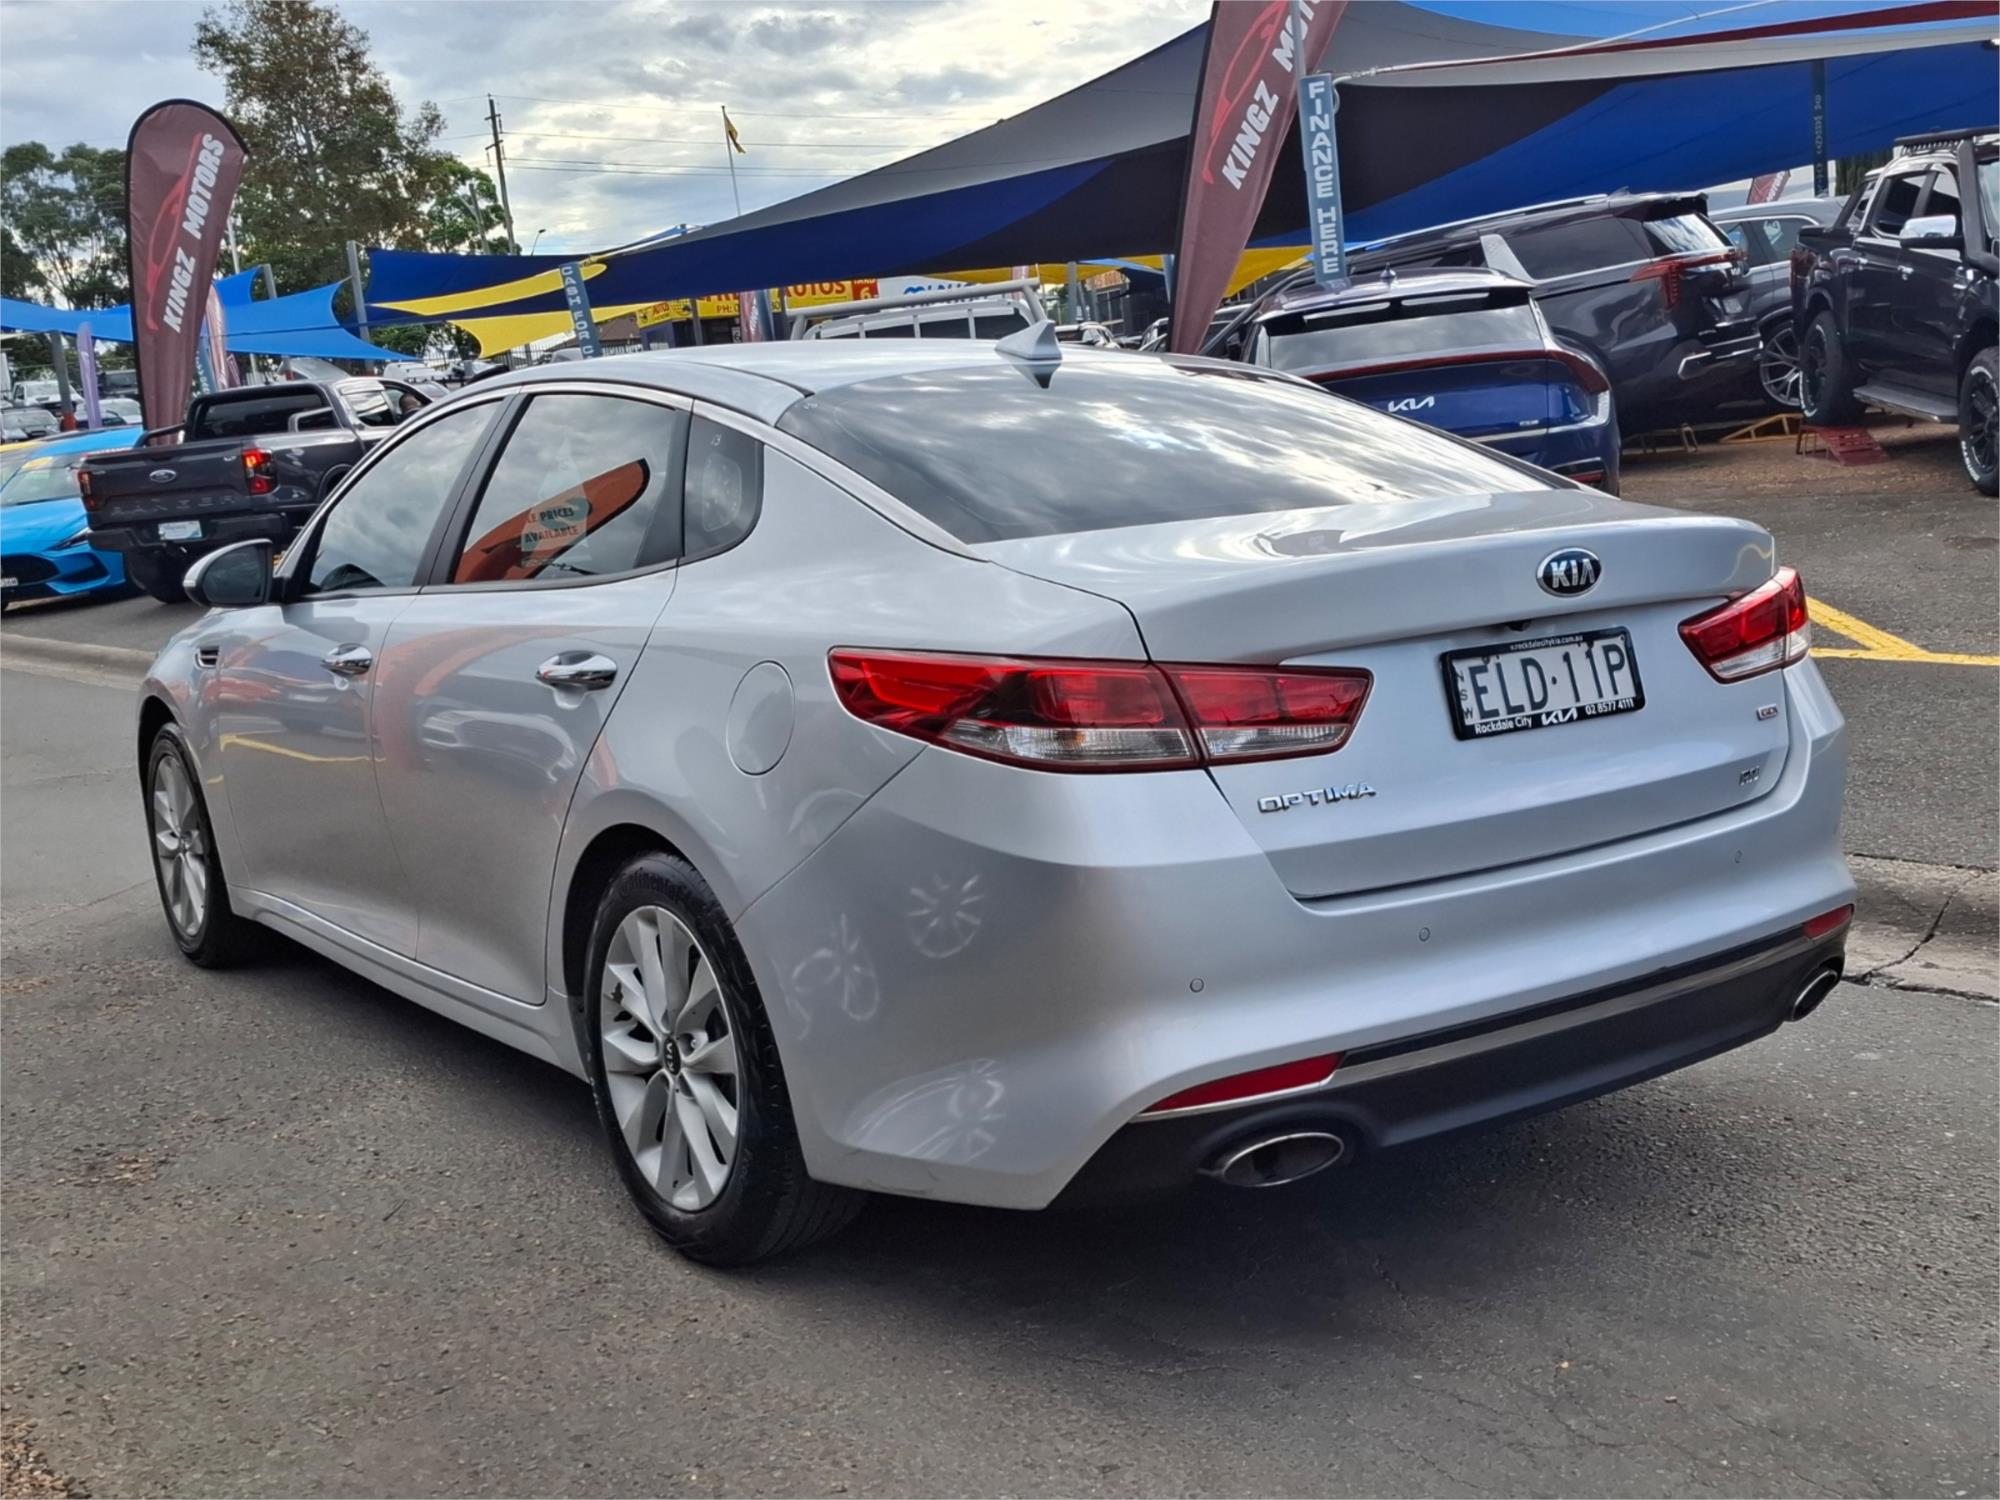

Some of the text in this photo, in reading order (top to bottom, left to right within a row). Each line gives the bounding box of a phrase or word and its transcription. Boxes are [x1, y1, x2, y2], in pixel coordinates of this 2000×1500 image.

[1221, 80, 1279, 191] KINGZ
[1308, 81, 1340, 275] FINANCE HERE
[163, 133, 225, 334] KINGZ MOTORS
[787, 281, 846, 297] UTOS
[561, 266, 595, 358] CASH FOR C
[1388, 396, 1435, 413] KIA
[540, 507, 575, 522] PRICES
[525, 525, 578, 543] AVAILABLE
[1550, 558, 1596, 589] KIA
[1474, 698, 1634, 734] Rockdale City KIA 02 8577 4111
[1258, 782, 1377, 813] OPTIMA
